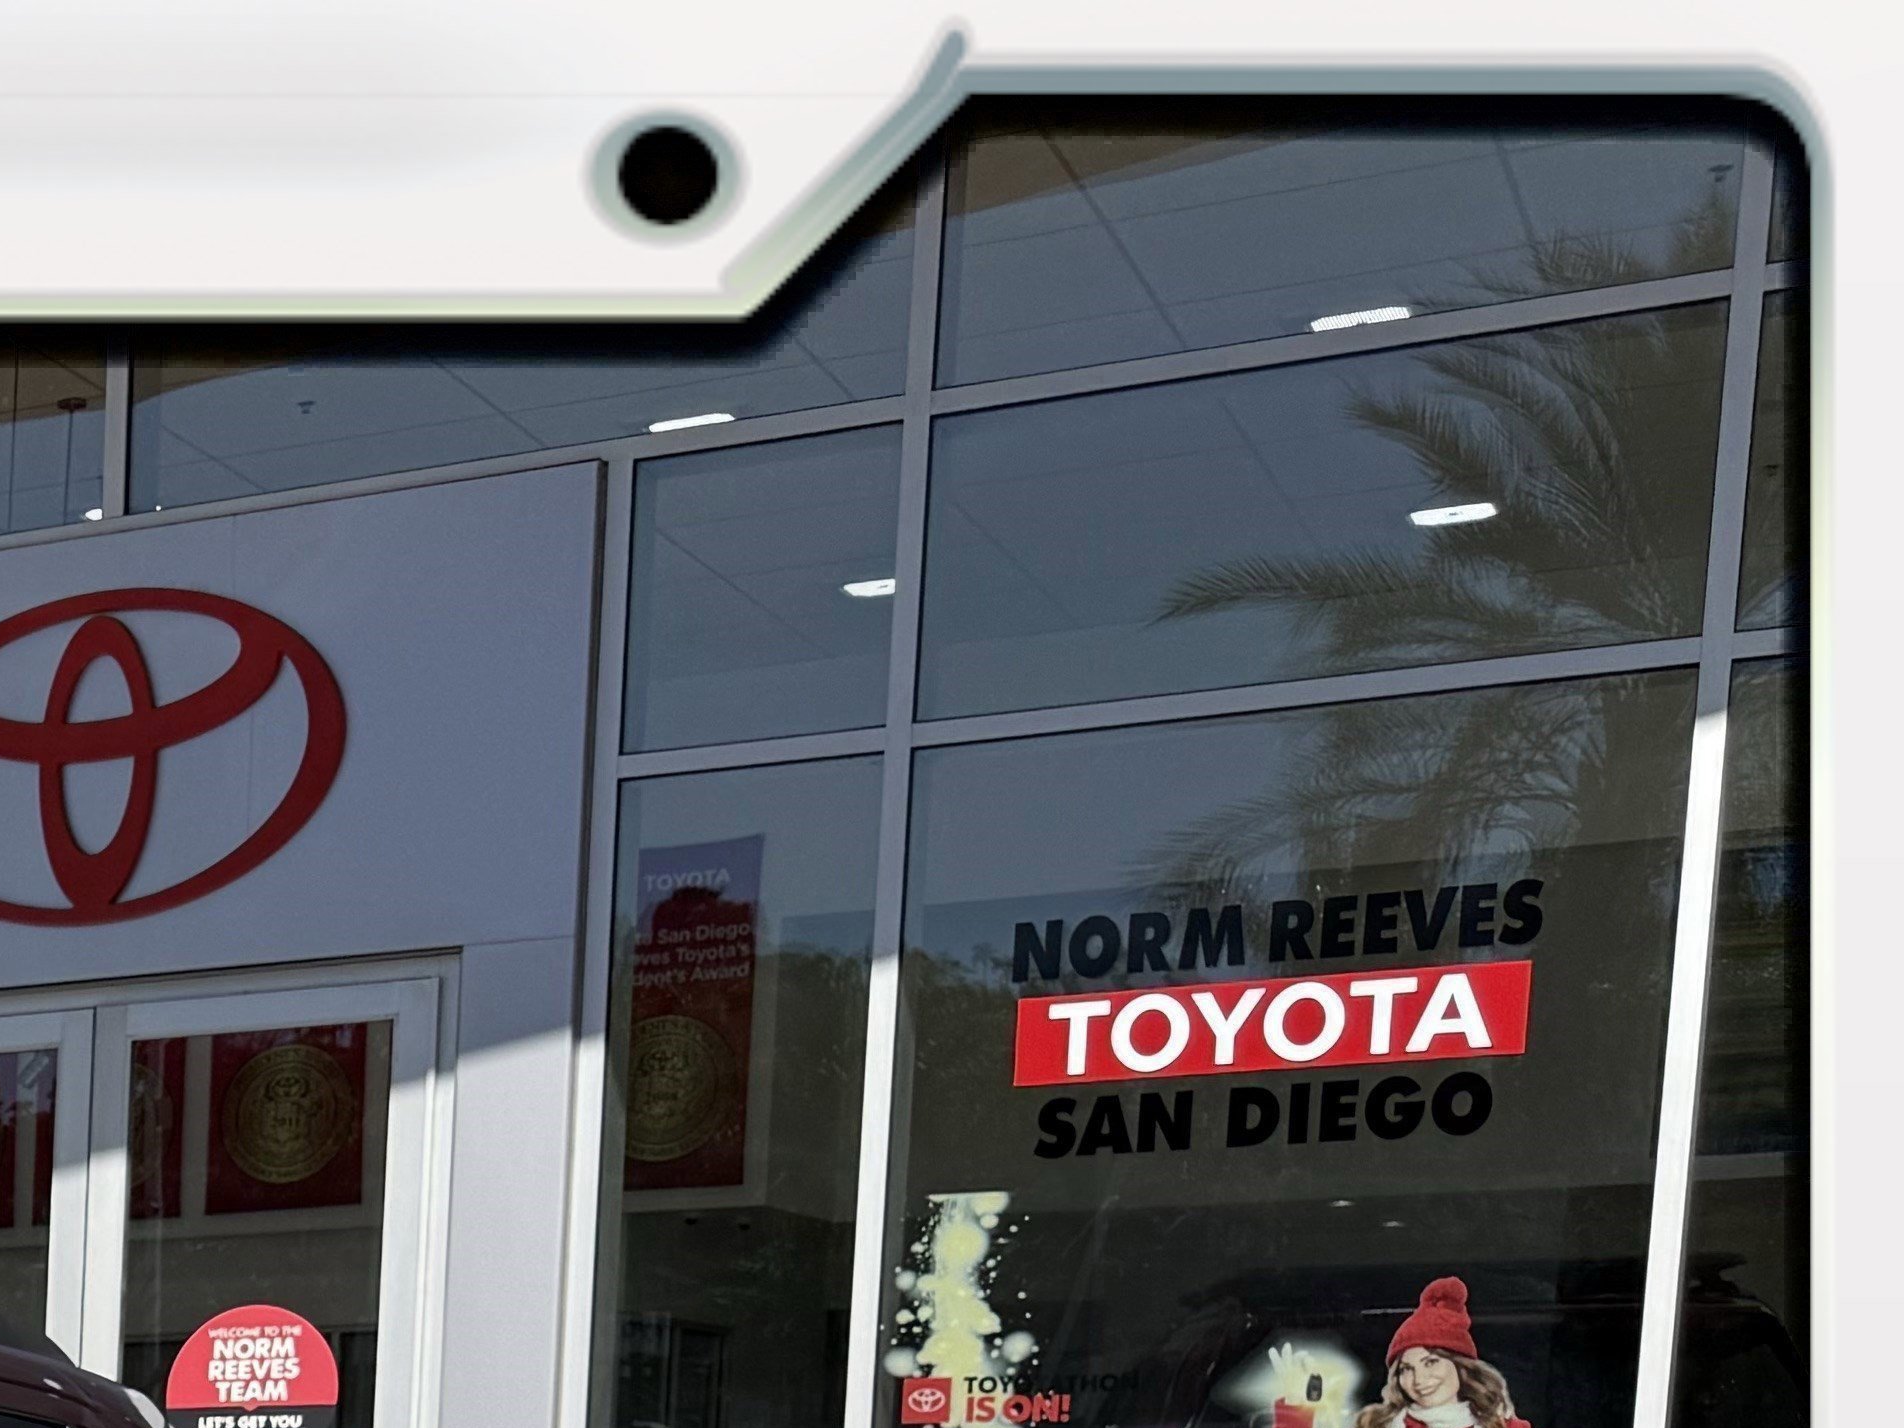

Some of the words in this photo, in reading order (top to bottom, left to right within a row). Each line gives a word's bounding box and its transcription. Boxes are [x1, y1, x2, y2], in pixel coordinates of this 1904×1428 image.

[643, 868, 730, 892] TOYOTA
[1012, 905, 1245, 983] NORM
[1268, 879, 1544, 963] REEVES
[1048, 973, 1493, 1077] TOYOTA
[1033, 1090, 1195, 1160] SAN
[1226, 1071, 1493, 1149] DIEGO
[208, 1327, 261, 1338] WELCOME
[263, 1326, 280, 1337] TO
[282, 1325, 302, 1336] THE
[213, 1337, 295, 1359] NORM
[208, 1357, 300, 1381] REEVES
[215, 1379, 288, 1402] TEAM
[964, 1369, 1140, 1394] TOYOATHON
[965, 1396, 996, 1423] IS
[1003, 1393, 1071, 1423] ON!
[237, 1415, 267, 1428] GET
[269, 1414, 303, 1428] YOU
